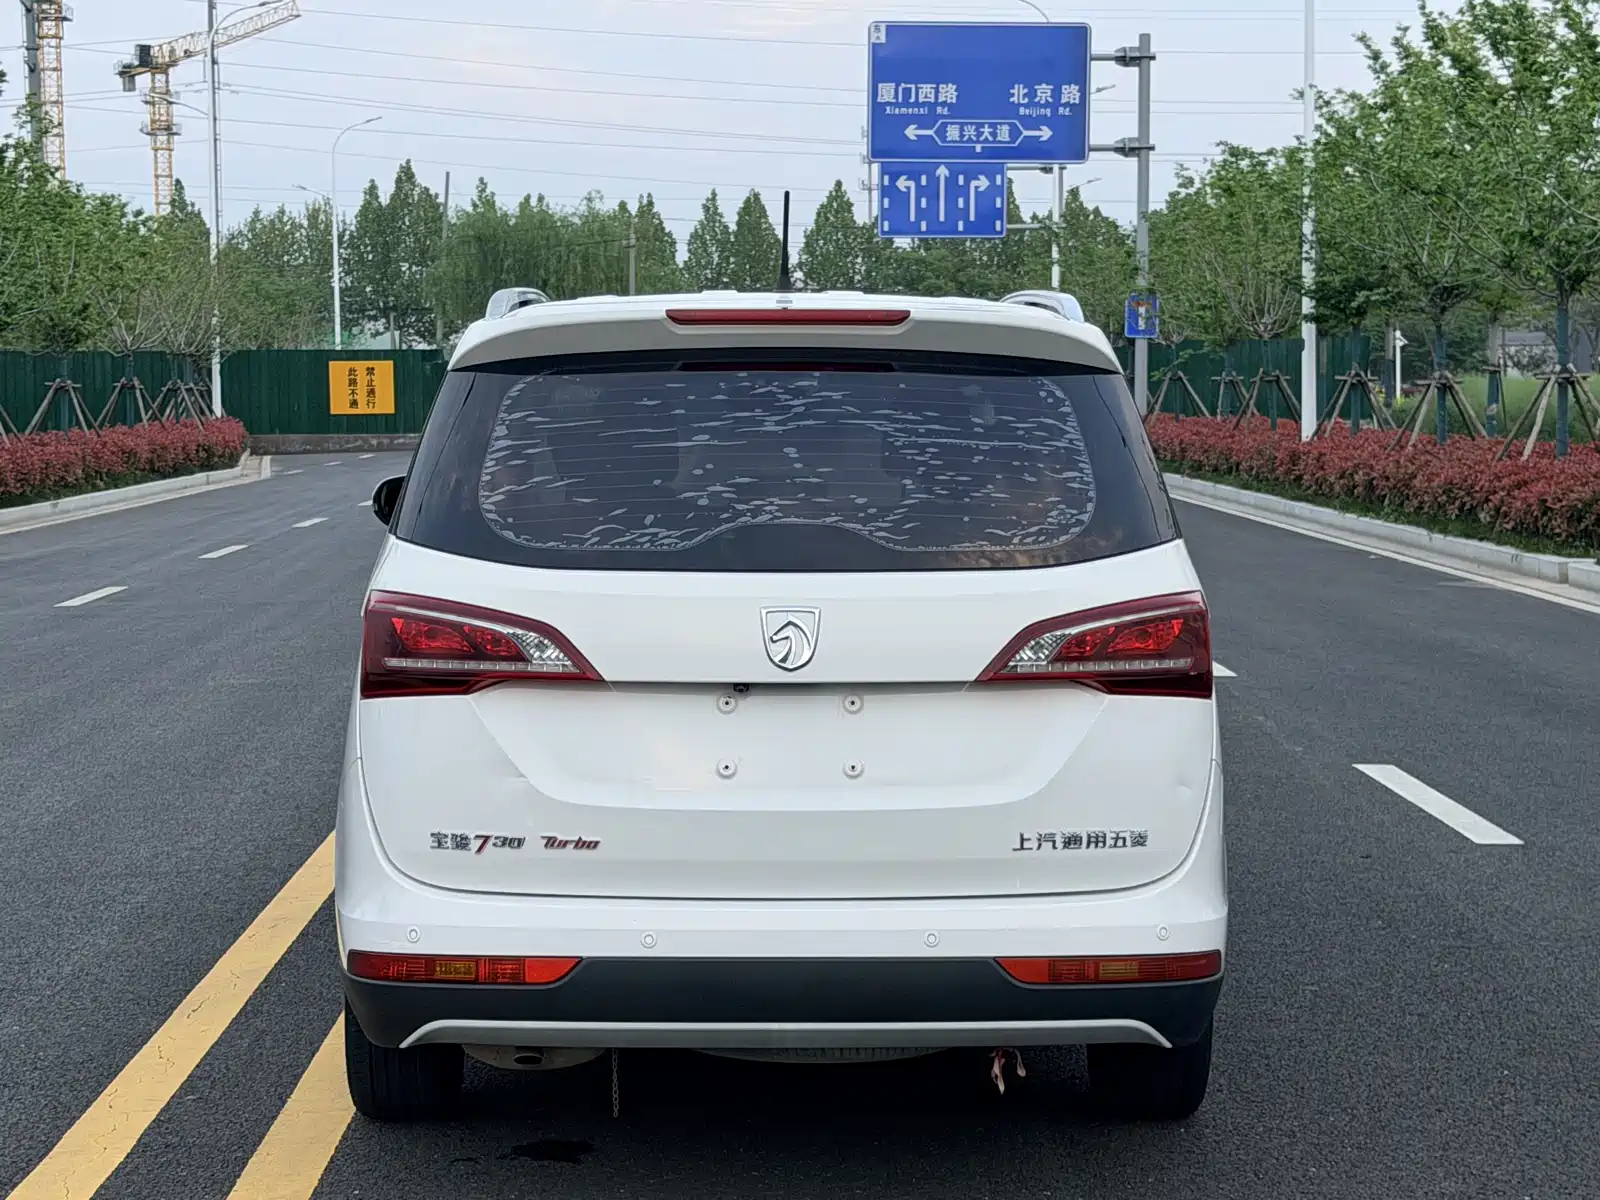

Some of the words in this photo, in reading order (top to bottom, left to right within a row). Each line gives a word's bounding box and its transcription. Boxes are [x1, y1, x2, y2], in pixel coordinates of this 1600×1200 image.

[876, 82, 958, 104] 厦门西路
[1009, 83, 1081, 105] 北京路
[884, 105, 928, 115] Xiamenxi
[935, 105, 952, 115] Rd.
[1018, 106, 1051, 118] Beijing
[1058, 106, 1072, 116] Rd.
[945, 123, 1011, 142] 振兴大道
[347, 366, 359, 410] 此路不通
[365, 366, 376, 410] 禁止通行
[540, 835, 601, 850] Turbo
[1012, 829, 1149, 851] 上汽通用五菱
